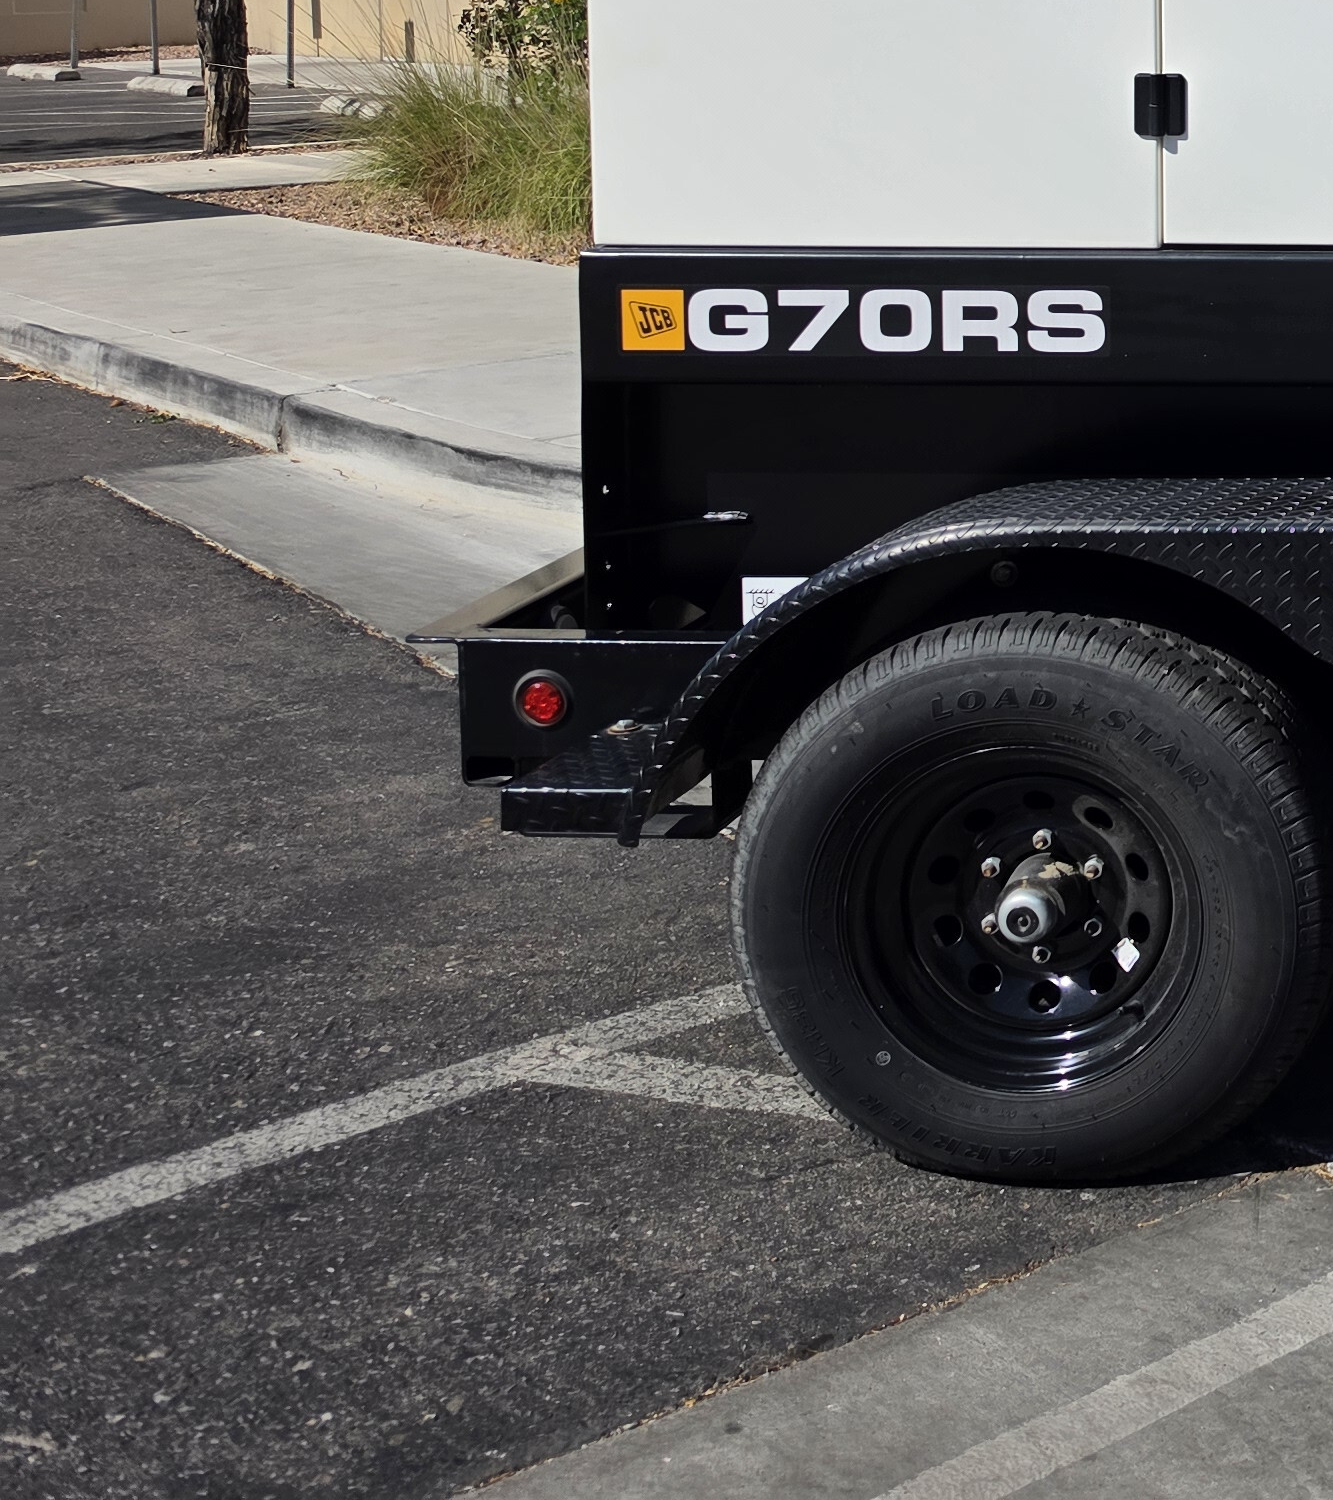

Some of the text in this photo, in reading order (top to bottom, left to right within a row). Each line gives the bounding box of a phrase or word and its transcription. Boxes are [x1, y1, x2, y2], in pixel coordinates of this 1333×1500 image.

[638, 304, 677, 338] JCB
[688, 288, 1106, 353] G70RS
[930, 685, 1211, 796] LOAD STAR
